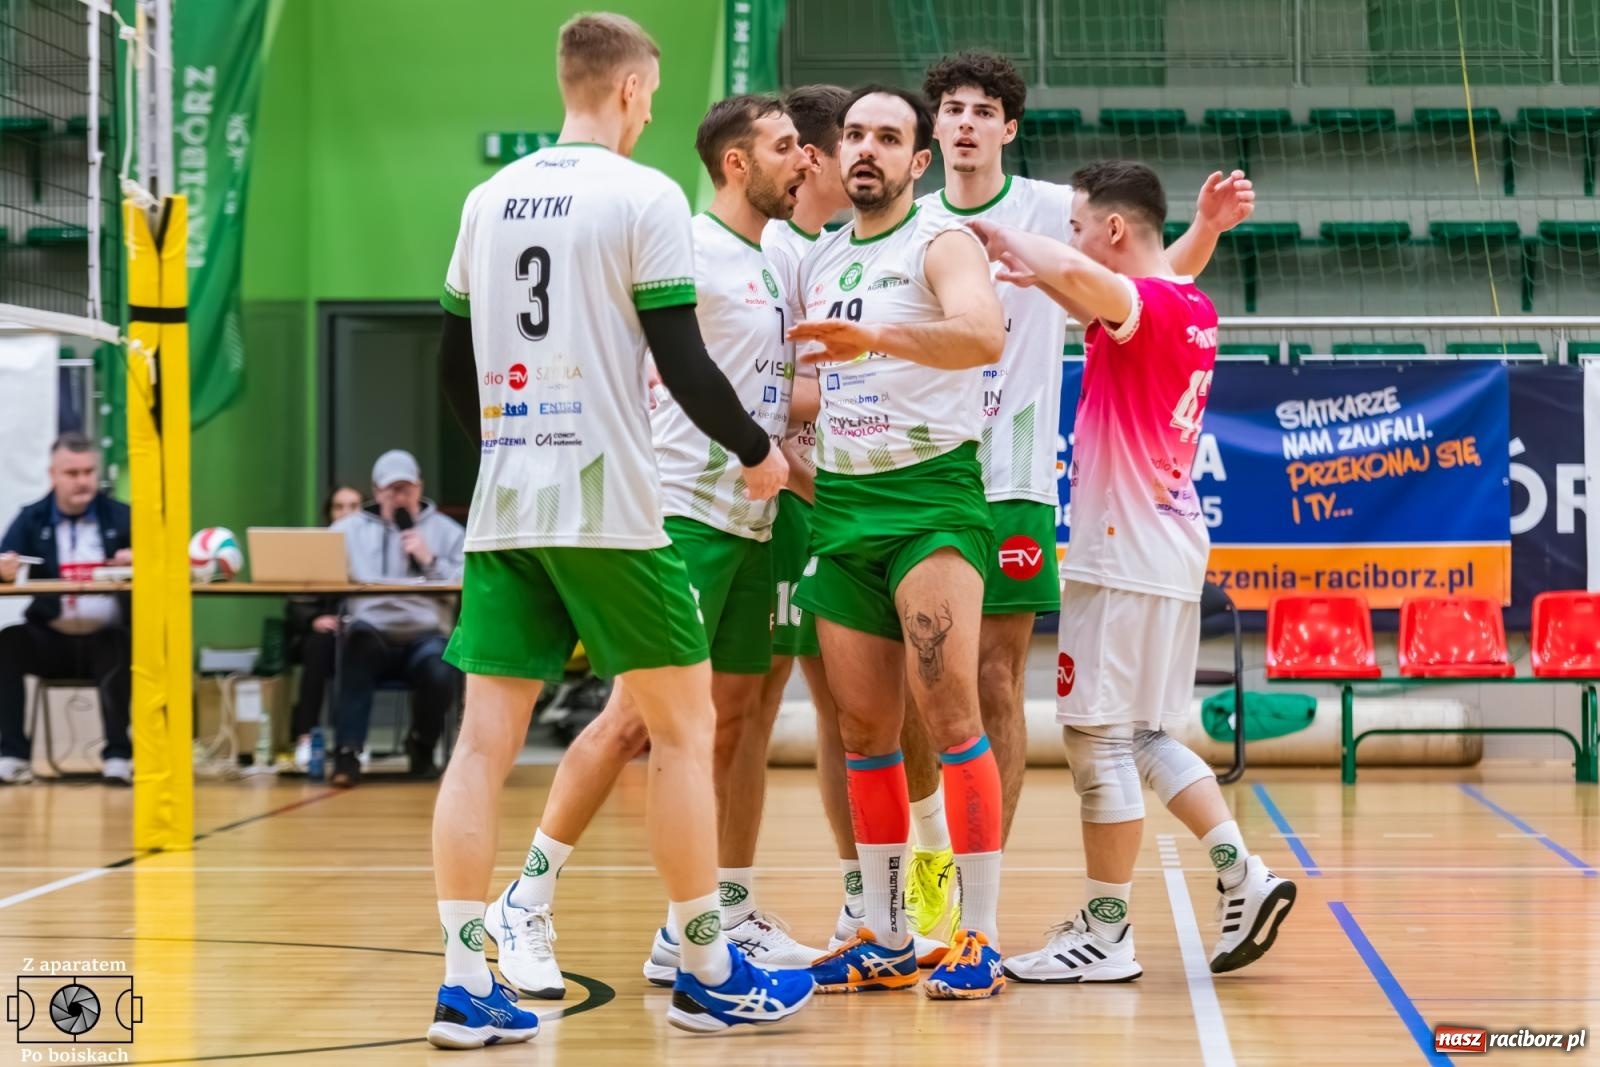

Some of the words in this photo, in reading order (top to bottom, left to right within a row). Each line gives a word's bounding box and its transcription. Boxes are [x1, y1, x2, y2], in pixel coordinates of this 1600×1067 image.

[503, 195, 573, 220] RZYTKI
[515, 246, 551, 341] 3
[1276, 386, 1400, 430] SIATKARZE
[1282, 427, 1332, 459] NAM
[1338, 413, 1433, 450] ZAUFALI.
[1287, 444, 1429, 491] PRZEKONAJ
[1436, 436, 1481, 468] SIĘ
[1293, 497, 1300, 524] I
[1304, 492, 1353, 521] TY...
[998, 548, 1042, 568] RV
